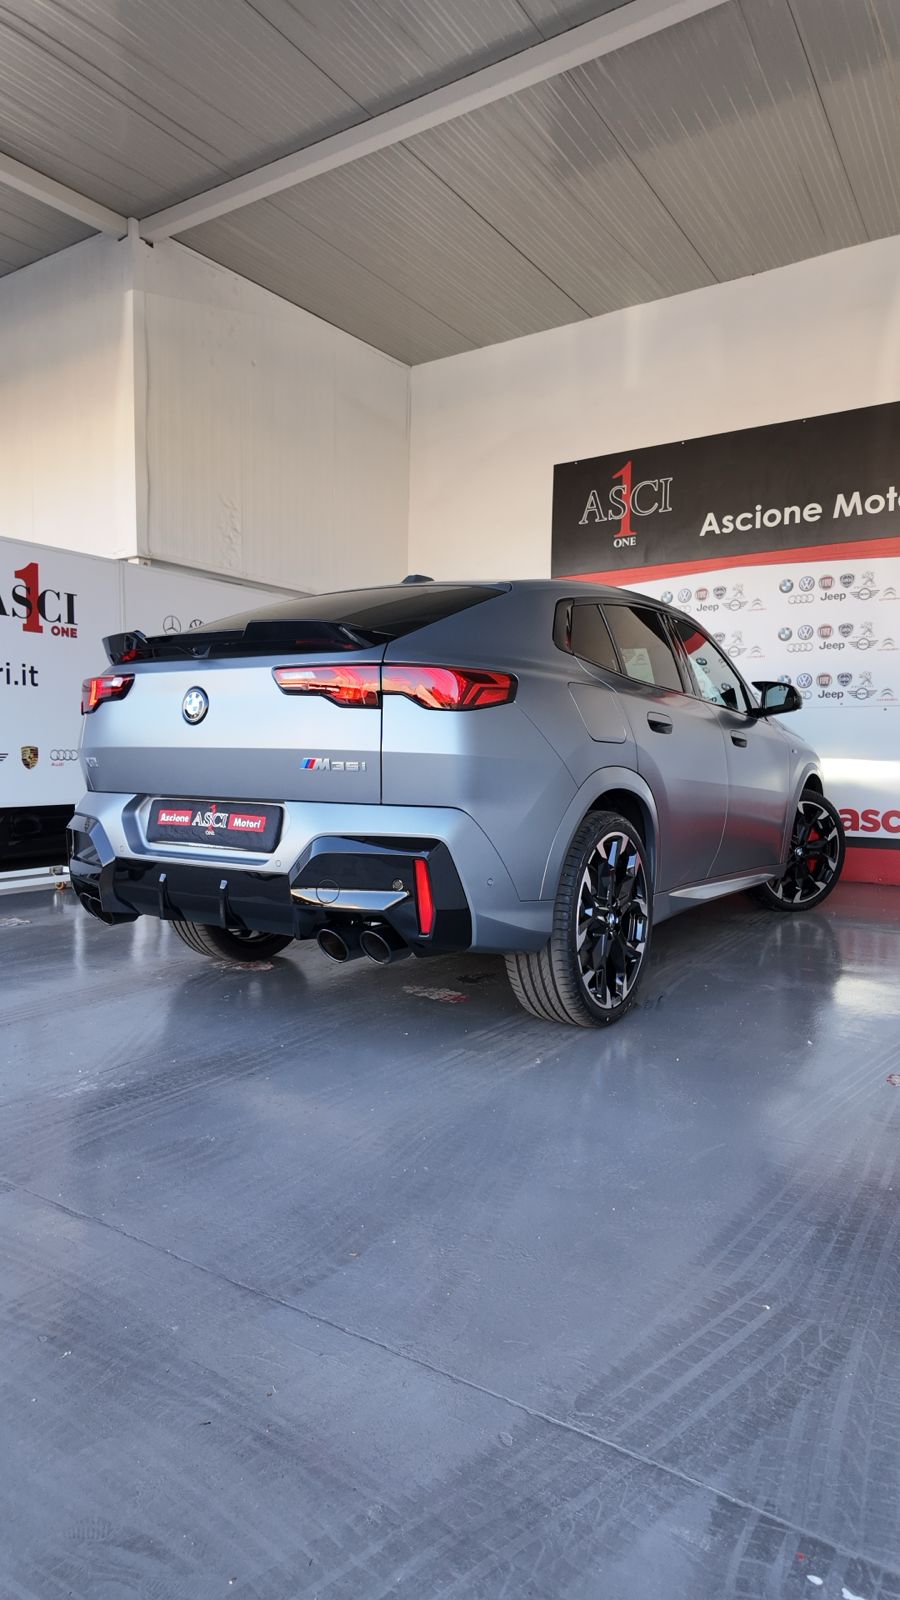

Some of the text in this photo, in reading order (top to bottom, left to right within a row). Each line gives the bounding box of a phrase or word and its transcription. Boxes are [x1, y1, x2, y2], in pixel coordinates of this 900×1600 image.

[578, 477, 673, 525] ASCI
[700, 504, 823, 537] Ascione
[613, 536, 637, 548] ONE
[820, 592, 847, 602] Jeep
[696, 603, 719, 612] Jeep
[50, 625, 78, 639] ONE
[819, 641, 845, 651] Jeep
[818, 690, 844, 699] Jeep
[311, 758, 367, 771] M35i
[160, 811, 261, 829] Ascione ASCI Motori
